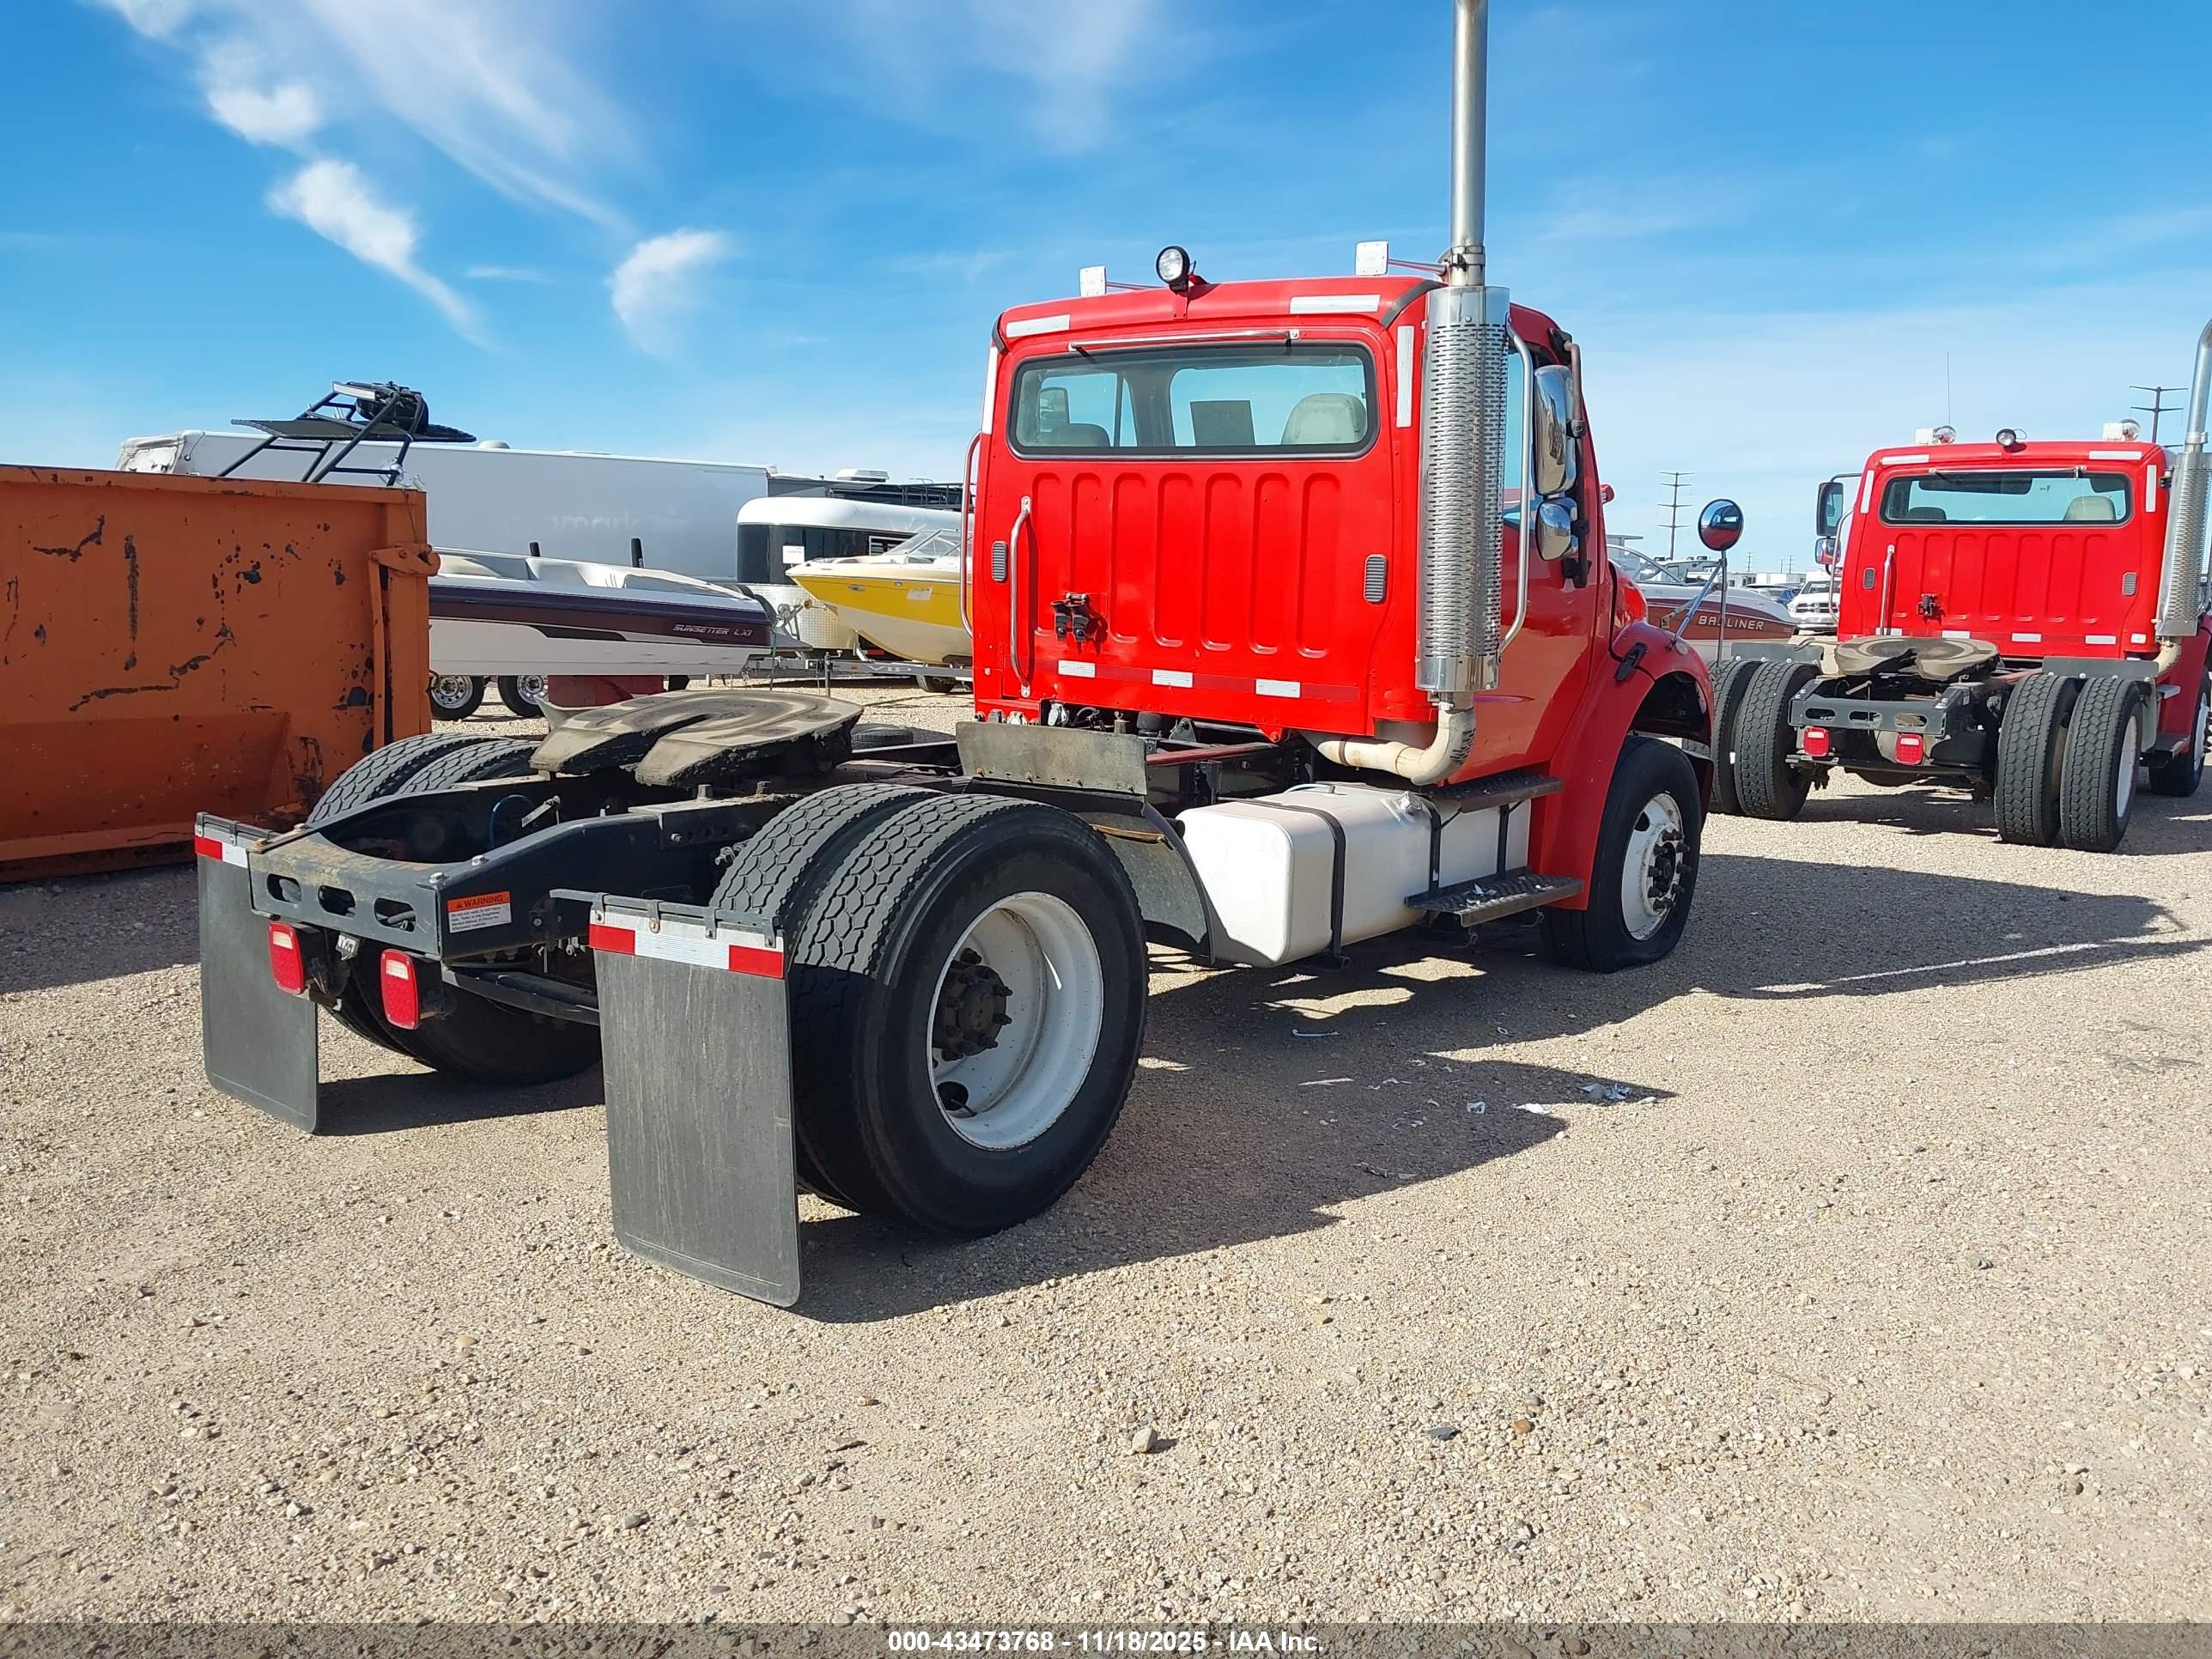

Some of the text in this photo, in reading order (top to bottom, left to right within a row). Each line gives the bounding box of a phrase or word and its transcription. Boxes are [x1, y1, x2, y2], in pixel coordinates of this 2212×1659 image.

[1698, 616, 1764, 629] BALINER
[672, 624, 730, 635] SUNSETTER
[465, 895, 503, 907] WARNING
